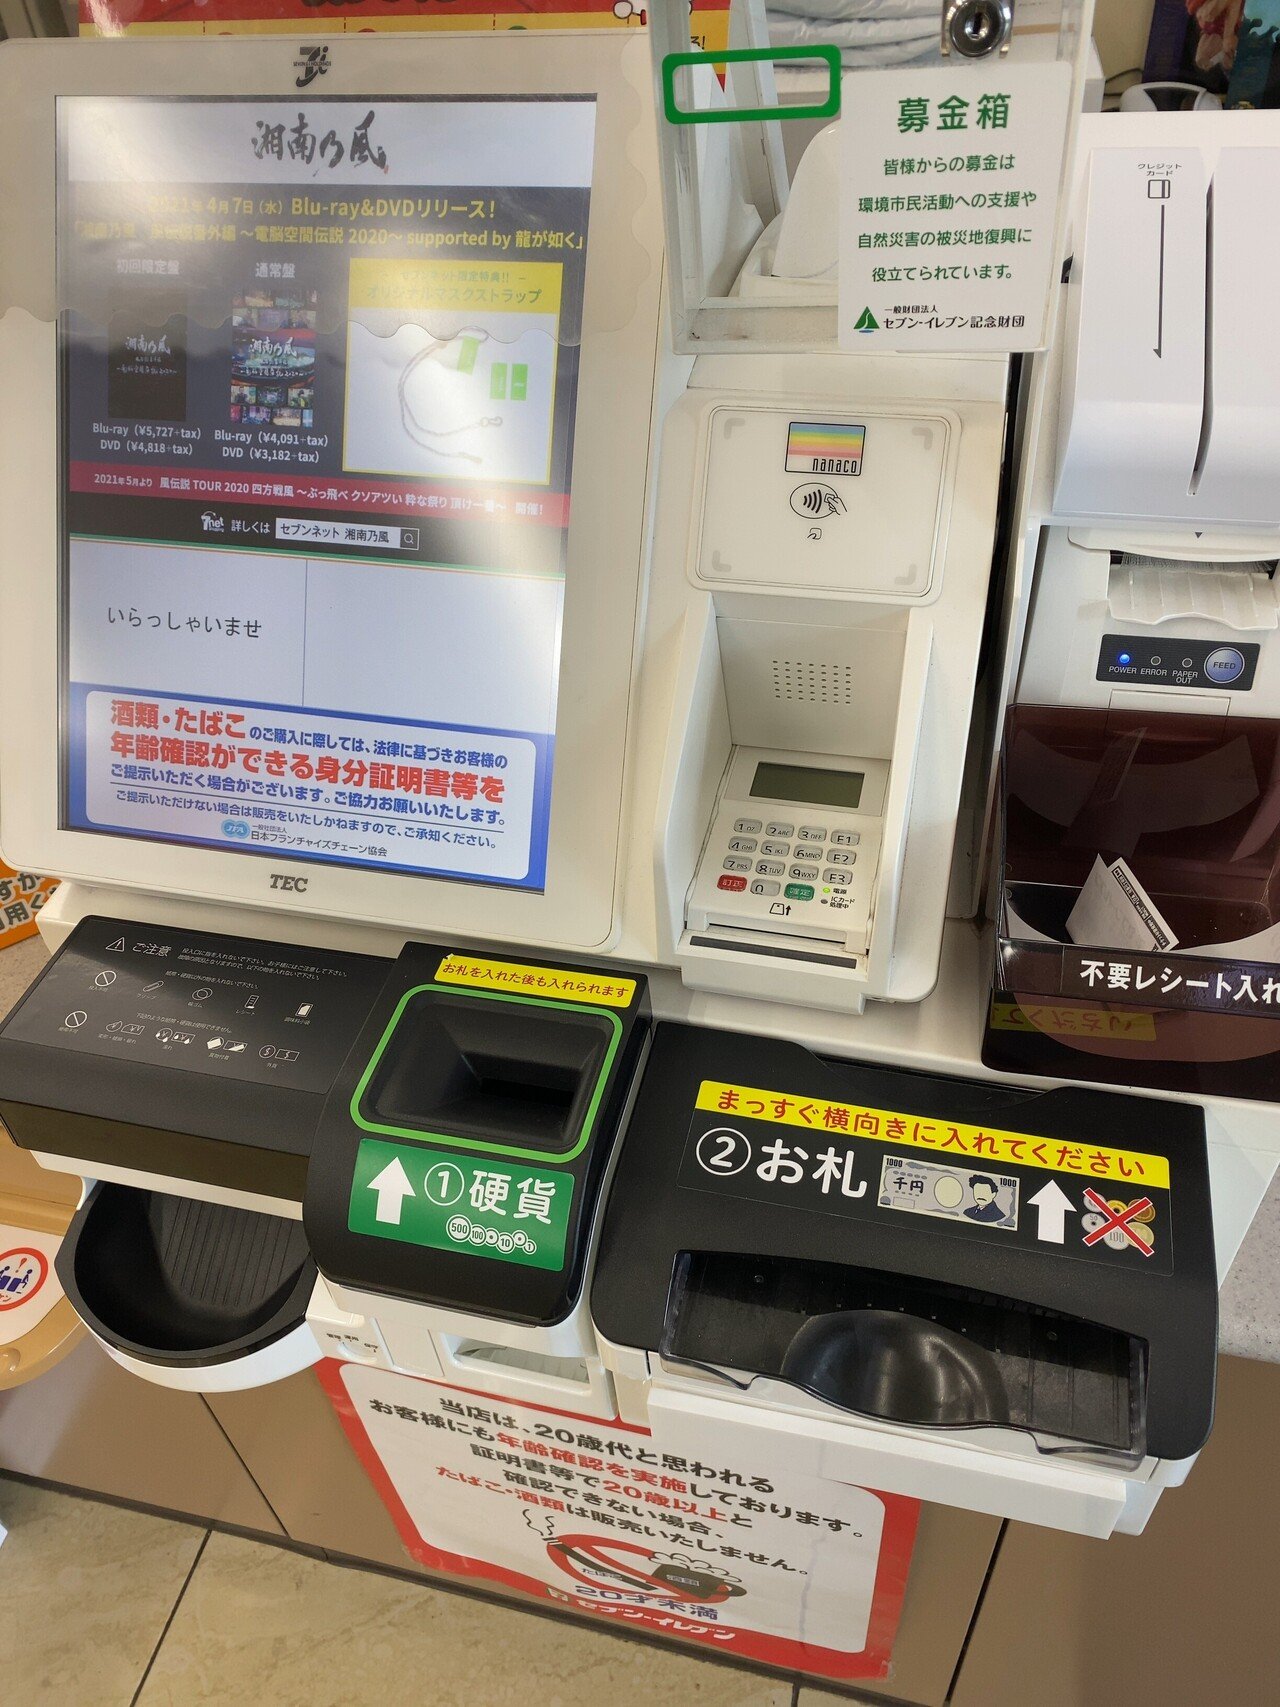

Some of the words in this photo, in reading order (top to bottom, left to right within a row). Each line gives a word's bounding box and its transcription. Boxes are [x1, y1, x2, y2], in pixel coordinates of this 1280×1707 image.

[897, 93, 1011, 134] 募金箱
[251, 110, 388, 172] 湘南乃風
[884, 154, 1015, 176] 皆様からの募金は
[858, 191, 1037, 213] 環境市民活動への支援や
[407, 231, 487, 249] supported
[492, 231, 511, 249] by
[515, 231, 584, 250] 龍が如く」
[858, 228, 1032, 248] 自然災害の被災地復興に
[255, 261, 296, 278] 通常盤
[872, 264, 1013, 282] 役立てられています。
[884, 305, 938, 314] 一般財団法人
[883, 315, 1025, 329] セブン-イレブン記念財団
[93, 423, 128, 436] Blu-ray
[214, 429, 252, 443] Blu-ray
[100, 440, 121, 451] DVD
[222, 447, 244, 458] DVD
[812, 458, 857, 473] nanaco
[160, 477, 190, 490] 風伝説
[193, 479, 222, 492] TOUR
[224, 481, 249, 494] 2020
[231, 520, 270, 533] 詳しくは
[280, 524, 340, 538] セブンネット
[344, 528, 389, 543] 湘南乃風
[107, 606, 262, 639] いらっしゃいませ
[1109, 665, 1137, 674] POWER
[1140, 667, 1167, 676] ERROR
[1172, 669, 1198, 678] PAPER
[1213, 661, 1236, 670] FEED
[111, 699, 246, 739] 酒類・たばこ
[249, 726, 508, 769] のご購入に際しては、法律に基づきお客様の
[111, 731, 505, 803] 年齢確認ができる身分証明書等を
[111, 763, 505, 825] ご提示いただく場合がございます。ご協力お願いいたします。
[116, 789, 496, 849] ご提示いただけない場合は販売をいたしかねますので、ご承知ください。
[251, 830, 388, 857] 日本フランチャイズチェーン協会
[836, 835, 852, 845] F1
[765, 845, 772, 854] 5
[796, 849, 805, 859] 6
[727, 860, 735, 870] 7
[833, 854, 849, 863] F2
[759, 864, 768, 874] 8
[793, 868, 801, 877] 9
[269, 874, 309, 893] TEC
[829, 873, 846, 883] F3
[830, 896, 856, 904] ICカード
[133, 942, 172, 957] ご注意
[442, 963, 629, 998] お札を入れた後も入れられます
[716, 1089, 1145, 1177] まっすぐ横向きに入れてください
[886, 1157, 903, 1168] 1000
[893, 1177, 924, 1194] 千円
[1000, 1177, 1017, 1187] 1000
[451, 1223, 468, 1233] 500
[471, 1230, 484, 1240] 100
[500, 1237, 511, 1248] 10
[439, 1397, 775, 1494] 当店は、20歳代と思われる
[369, 1398, 863, 1538] お客様にも年齢確認を実施しております。
[470, 1443, 753, 1528] 証明書等で20歳以上と
[502, 1469, 724, 1538] 確認できない場合、
[436, 1465, 808, 1576] たばこ・酒類は販売いたしません。
[576, 1585, 718, 1620] 20才未満
[577, 1599, 736, 1640] セブン-イレブン
